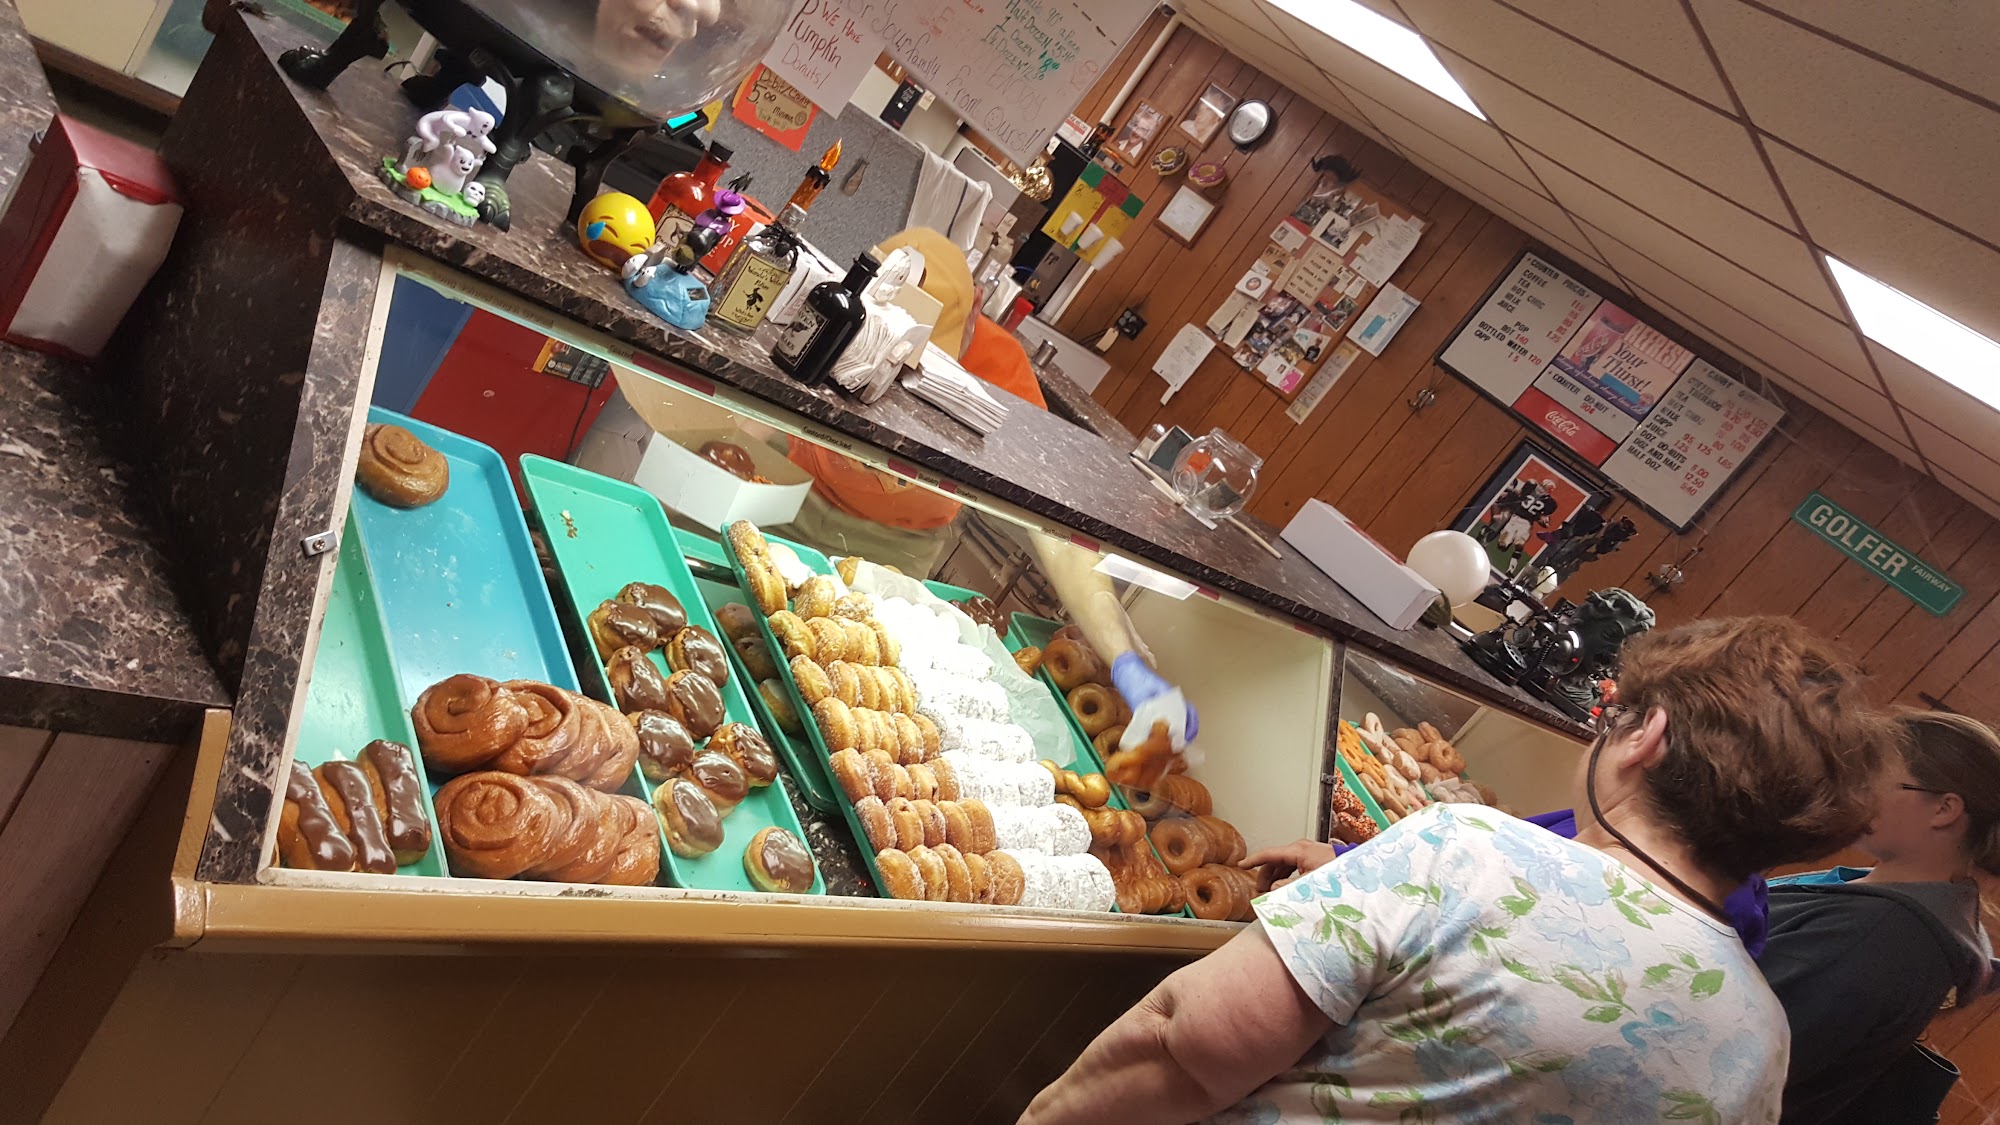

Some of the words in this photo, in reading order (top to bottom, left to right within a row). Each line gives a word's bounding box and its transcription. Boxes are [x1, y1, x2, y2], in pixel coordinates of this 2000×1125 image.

[822, 0, 839, 27] WE
[843, 18, 864, 44] HAVE
[1023, 15, 1051, 49] DOZEN
[902, 30, 941, 81] family
[1517, 277, 1530, 289] TEA
[1522, 268, 1547, 288] COFFEE
[1504, 291, 1520, 306] MILK
[1510, 284, 1525, 297] HOT
[1497, 298, 1515, 313] JUICE
[1473, 328, 1490, 343] CAPP
[1478, 320, 1506, 342] BOTTLED
[1506, 339, 1528, 356] WATER
[1513, 320, 1529, 334] POP
[1612, 341, 1648, 370] Your
[1622, 319, 1692, 374] REFRESH
[1552, 372, 1580, 395] COUNTER
[1601, 354, 1652, 393] Thirst!
[1675, 390, 1689, 403] TEA
[1652, 413, 1672, 430] CAPP
[1659, 405, 1680, 422] MILK
[1645, 420, 1667, 439] JUICE
[1626, 444, 1646, 461] HALF
[1644, 456, 1661, 471] DOZ
[1632, 436, 1649, 451] DOZ
[1647, 446, 1664, 461] AND
[1661, 456, 1681, 473] HALF
[1639, 429, 1656, 443] DOZ
[1656, 440, 1687, 464] DO-NUTS
[1521, 494, 1545, 516] 32
[1807, 502, 1909, 577] GOLFER
[1911, 564, 1951, 592] FAIRWAY
